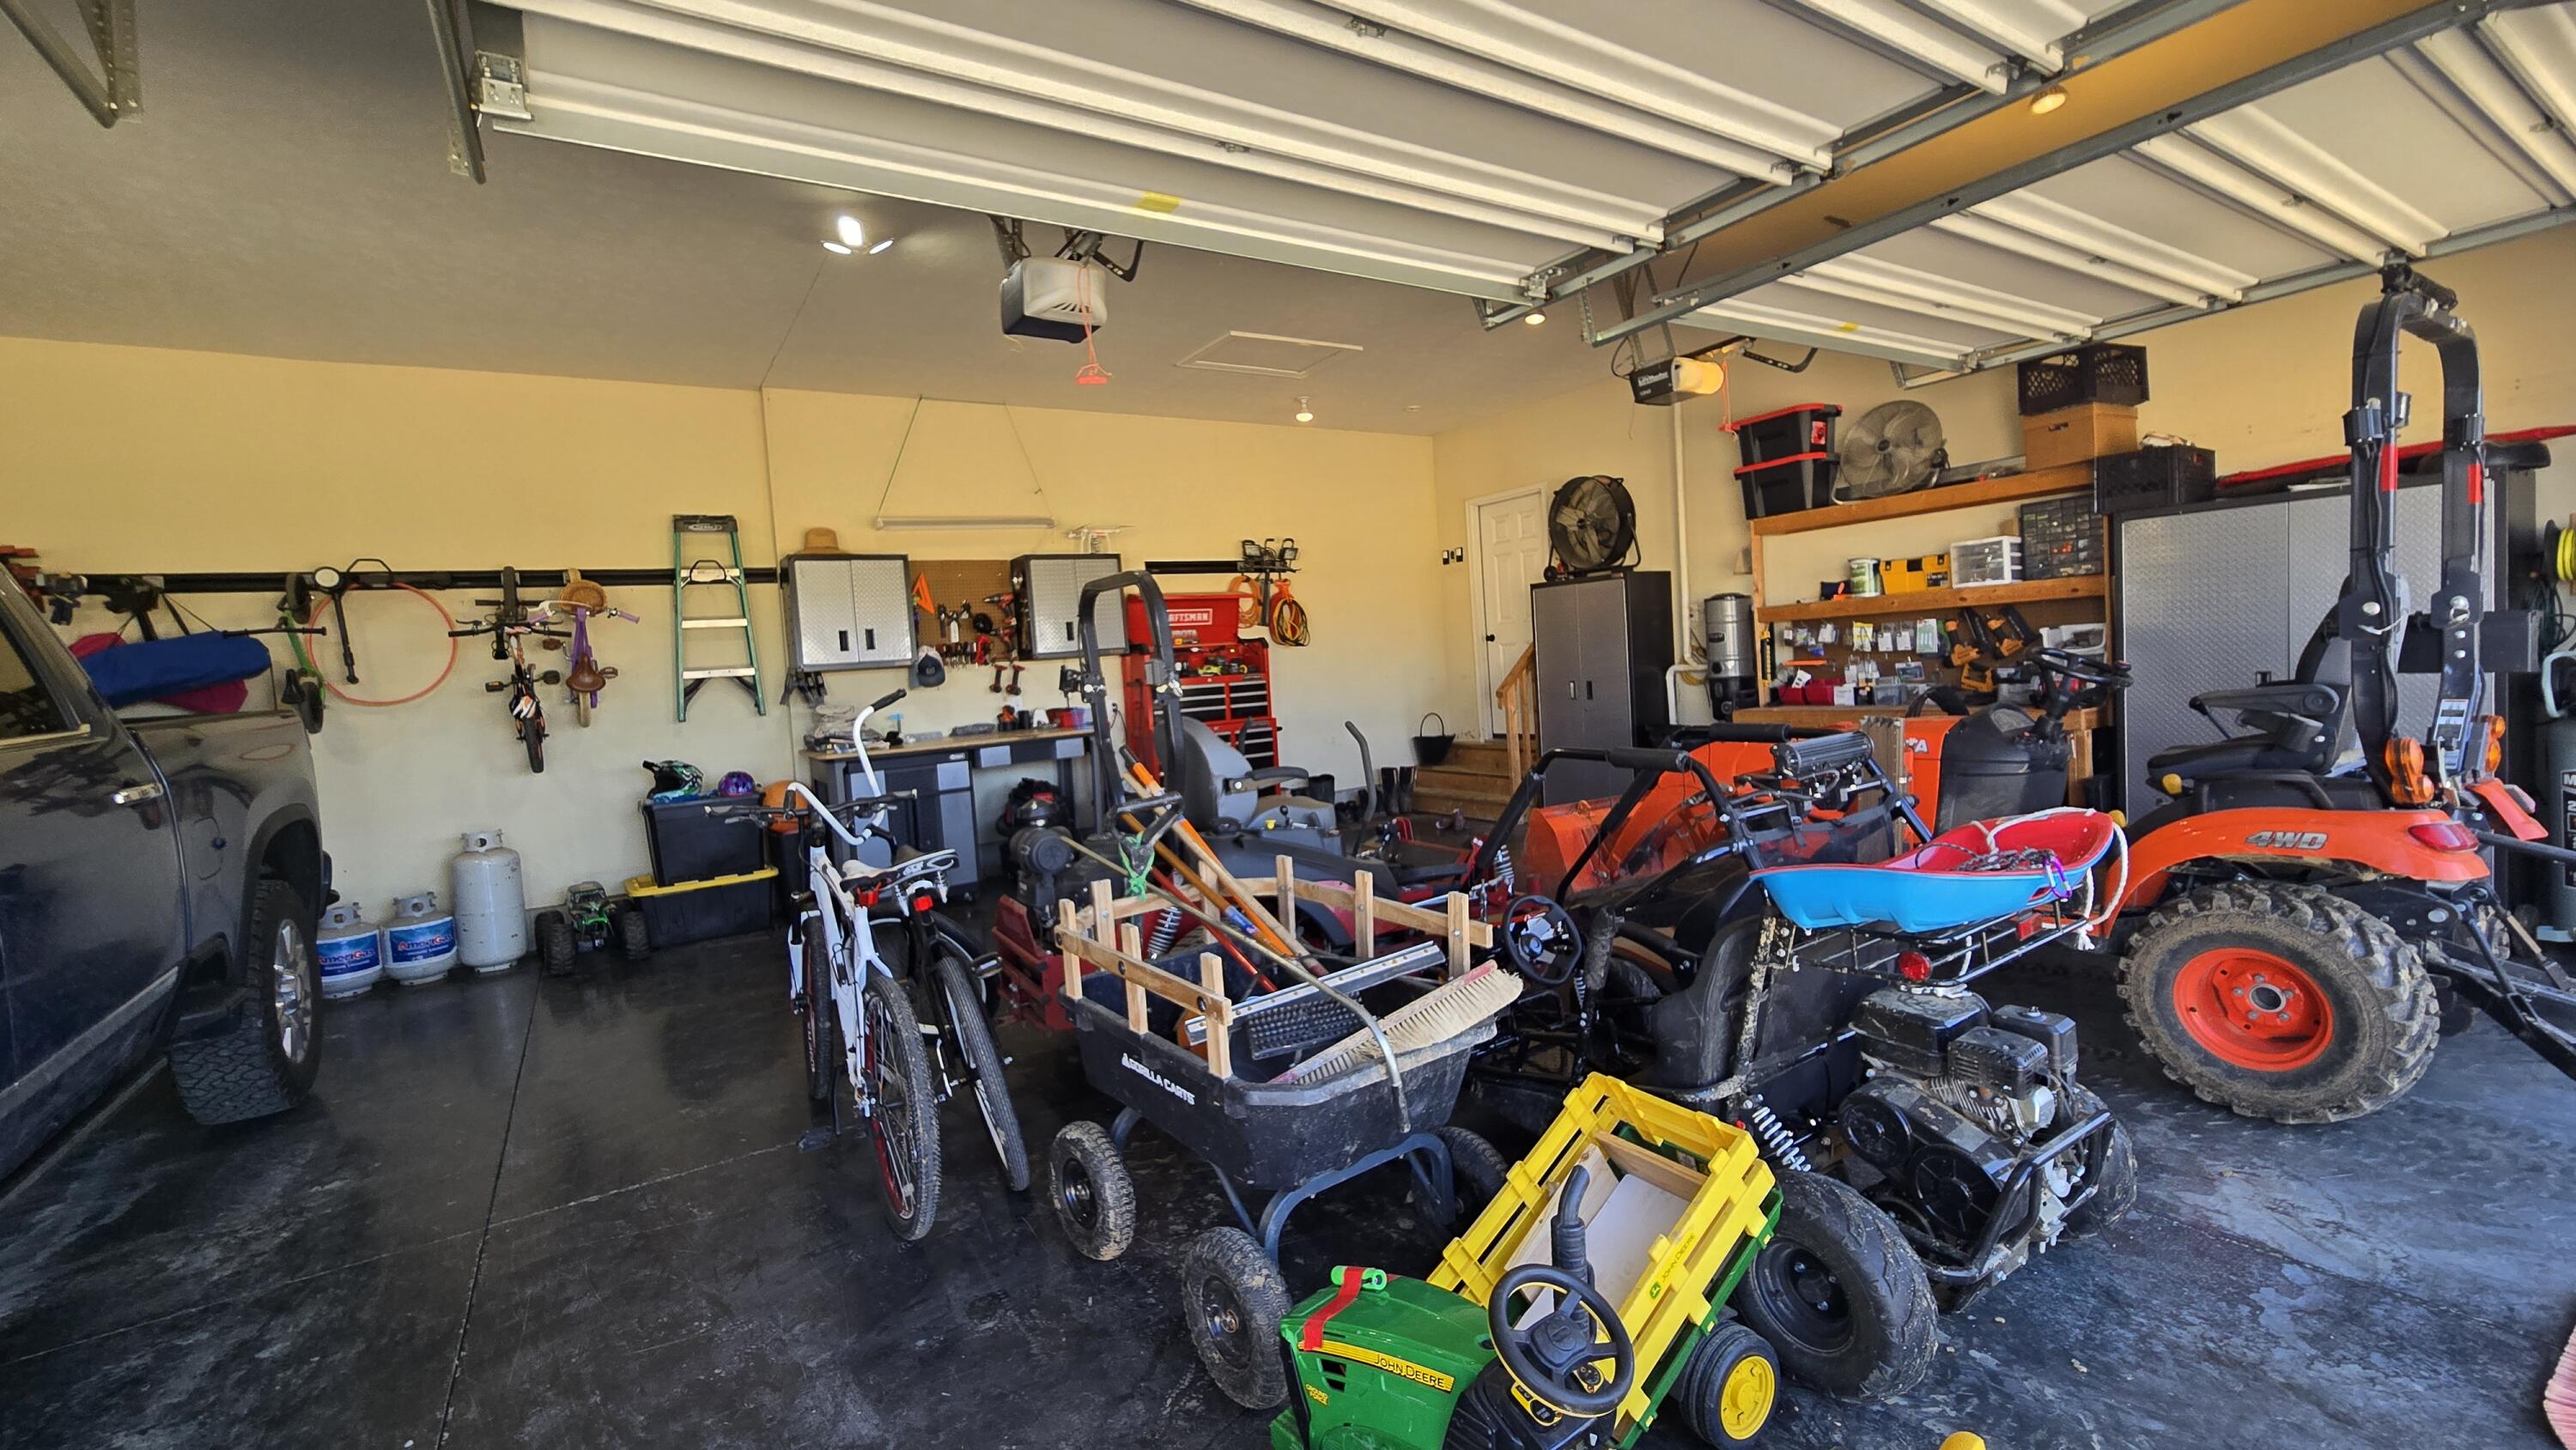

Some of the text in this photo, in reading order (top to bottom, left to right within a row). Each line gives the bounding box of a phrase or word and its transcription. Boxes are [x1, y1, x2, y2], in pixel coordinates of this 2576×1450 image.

[1168, 612, 1209, 622] AFTSMAN
[1905, 737, 1929, 753] TA
[2245, 830, 2329, 851] 4WD
[1374, 1354, 1444, 1388] JOHN DEERE
